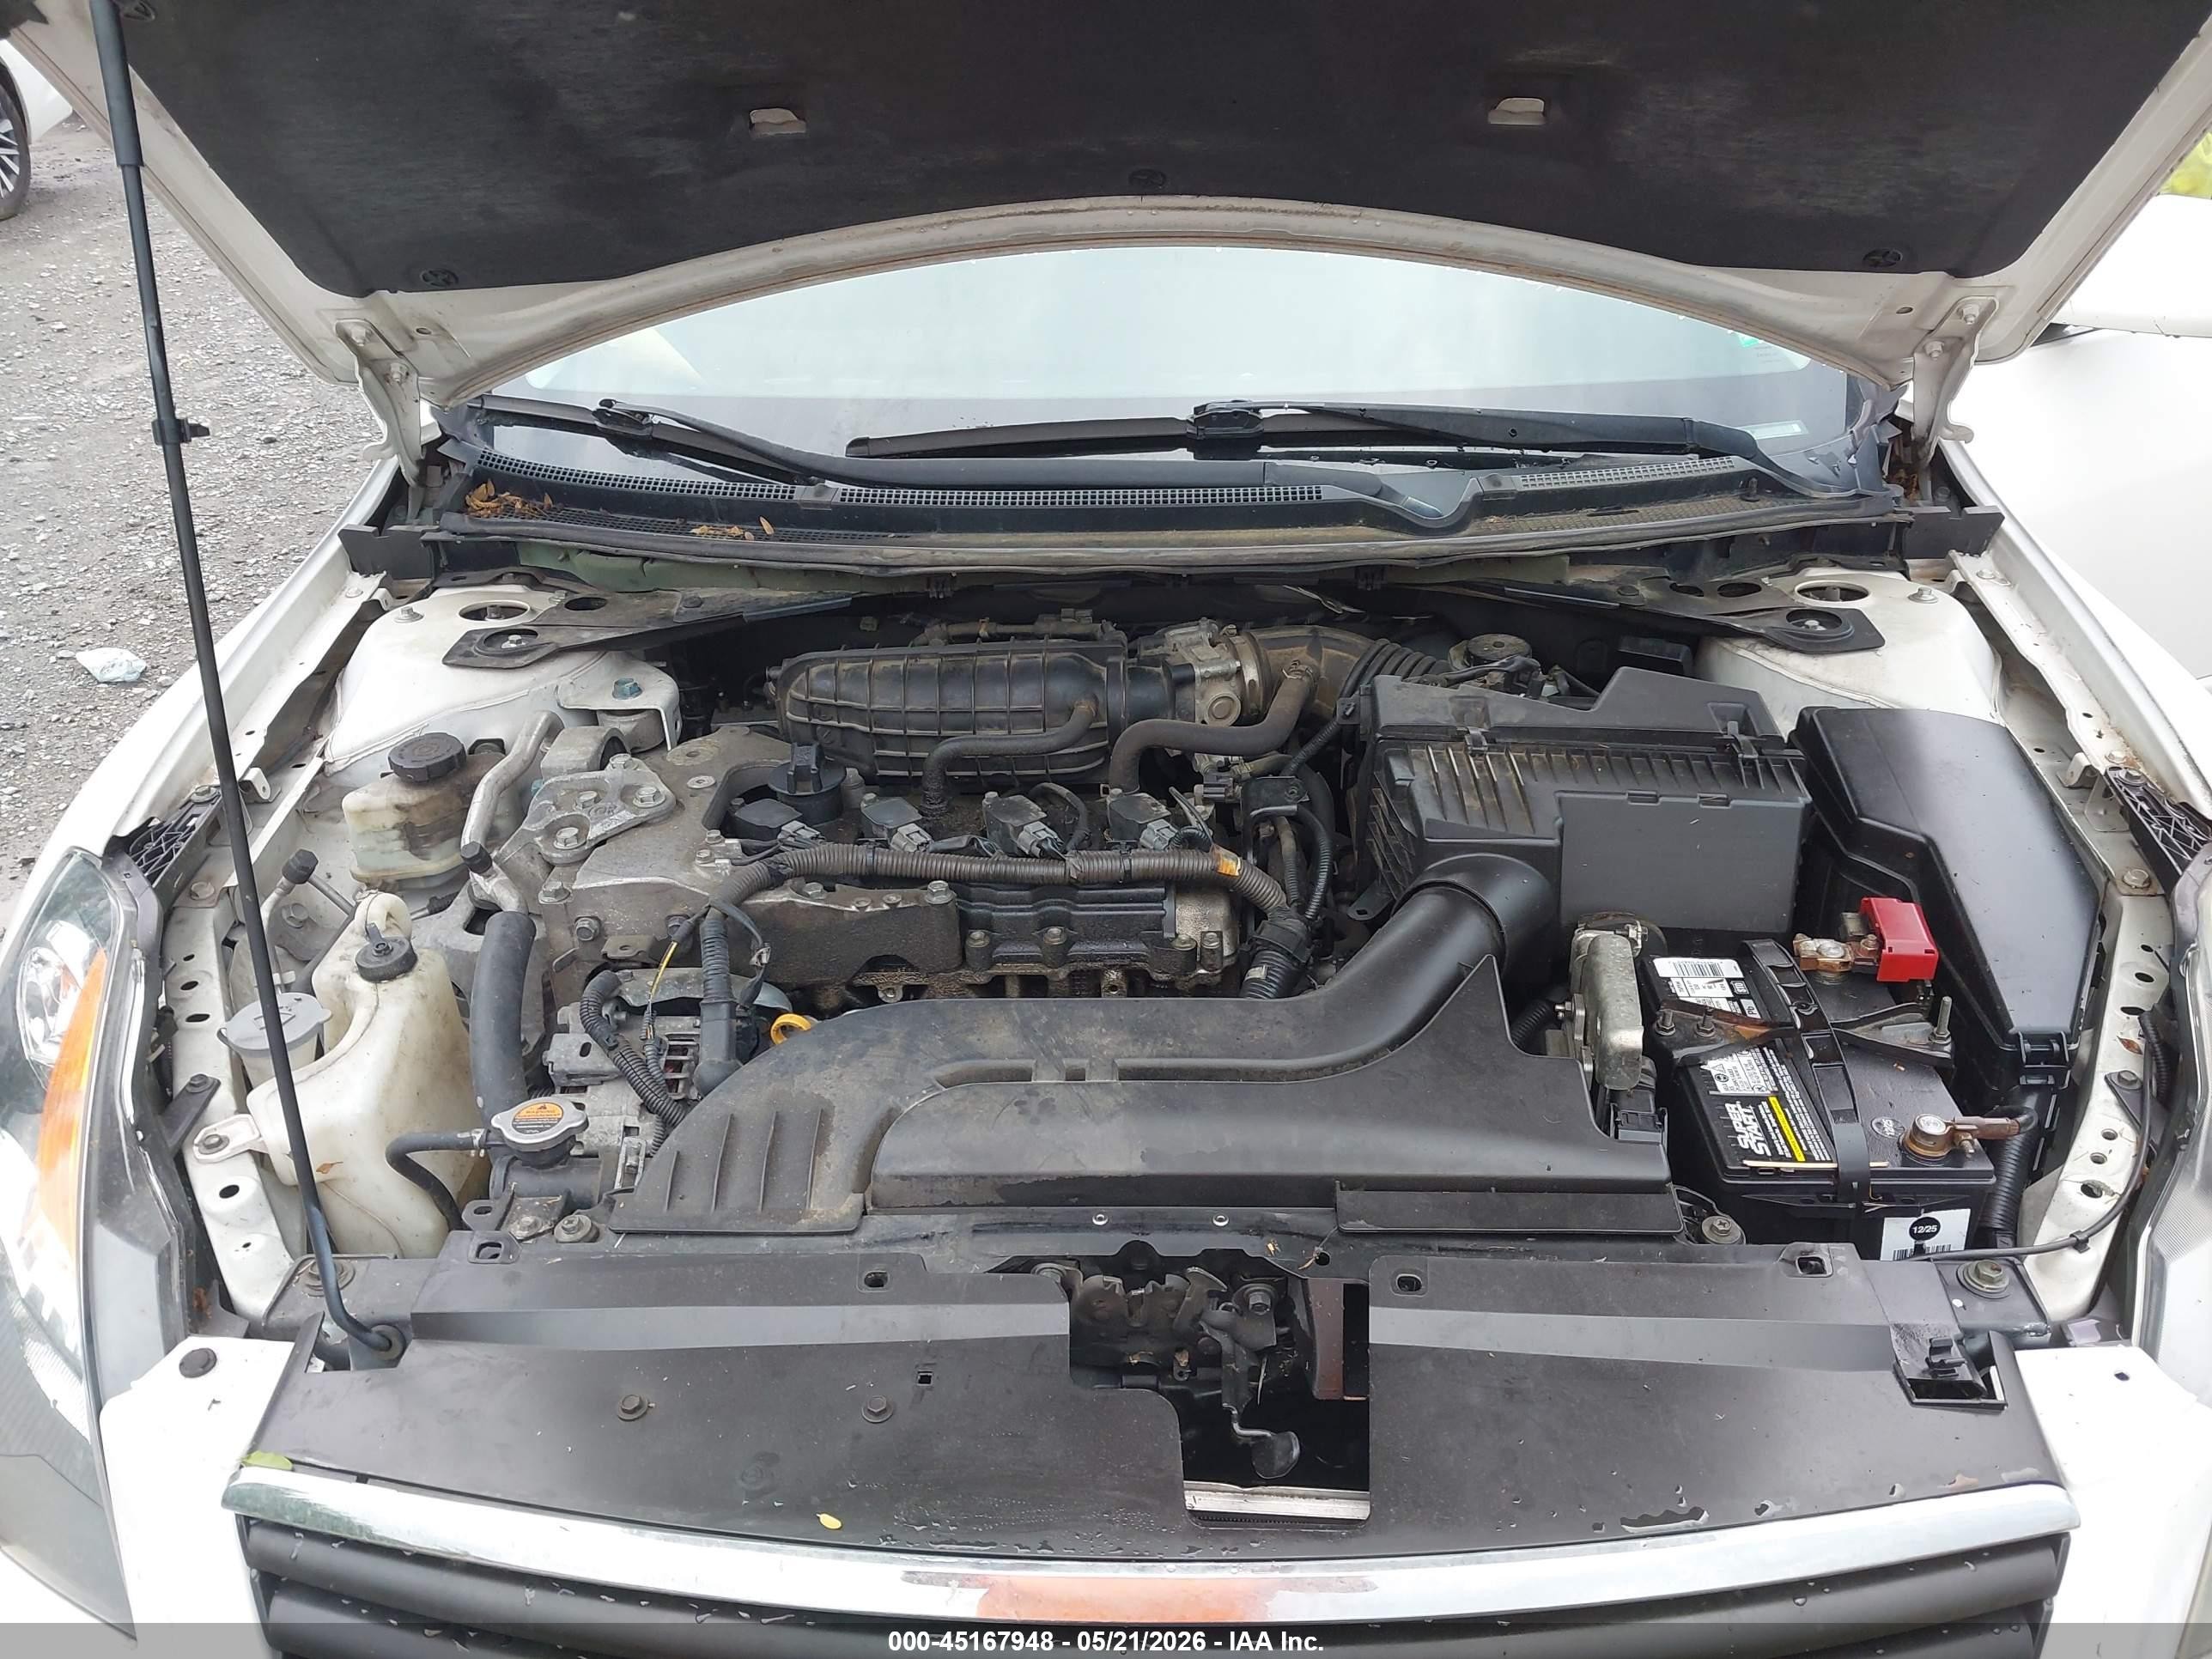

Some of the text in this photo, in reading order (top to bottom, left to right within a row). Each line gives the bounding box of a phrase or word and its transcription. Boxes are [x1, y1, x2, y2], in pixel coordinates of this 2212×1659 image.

[1748, 1006, 1758, 1016] Pb
[1724, 1102, 1752, 1150] SUPER
[1738, 1103, 1771, 1157] START
[1912, 1224, 1938, 1234] 12/25
